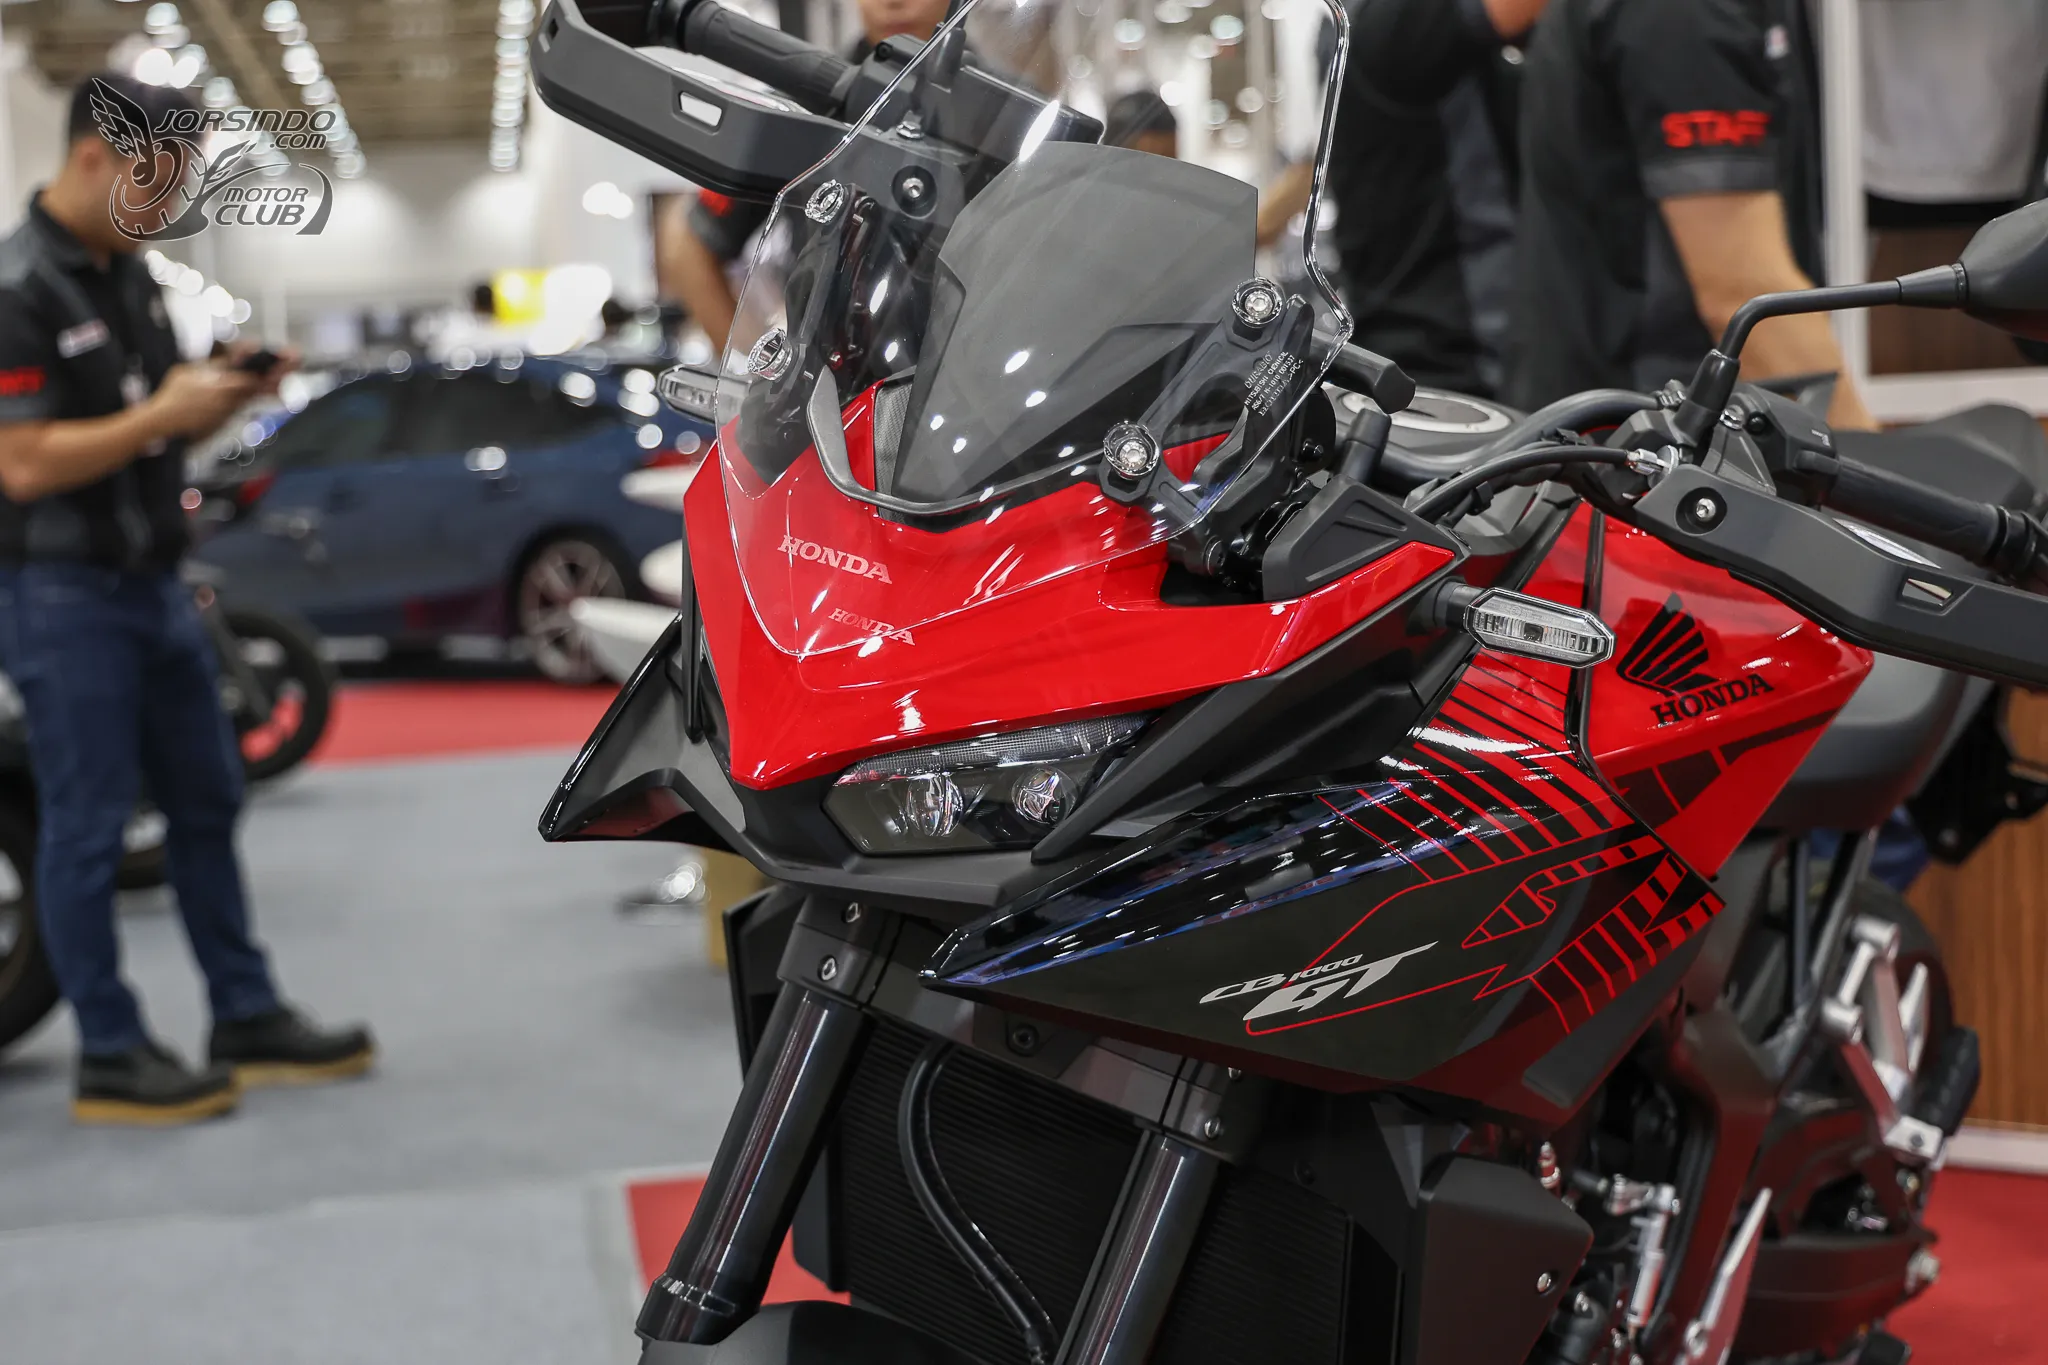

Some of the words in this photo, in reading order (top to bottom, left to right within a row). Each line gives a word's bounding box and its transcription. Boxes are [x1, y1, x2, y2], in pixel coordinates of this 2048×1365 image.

[1244, 375, 1269, 406] MITSUBISHI
[1267, 351, 1289, 375] CHEMICAL
[777, 535, 893, 584] HONDA
[828, 608, 916, 646] HONDA
[1651, 673, 1774, 725] HONDA
[1242, 940, 1439, 1021] GT
